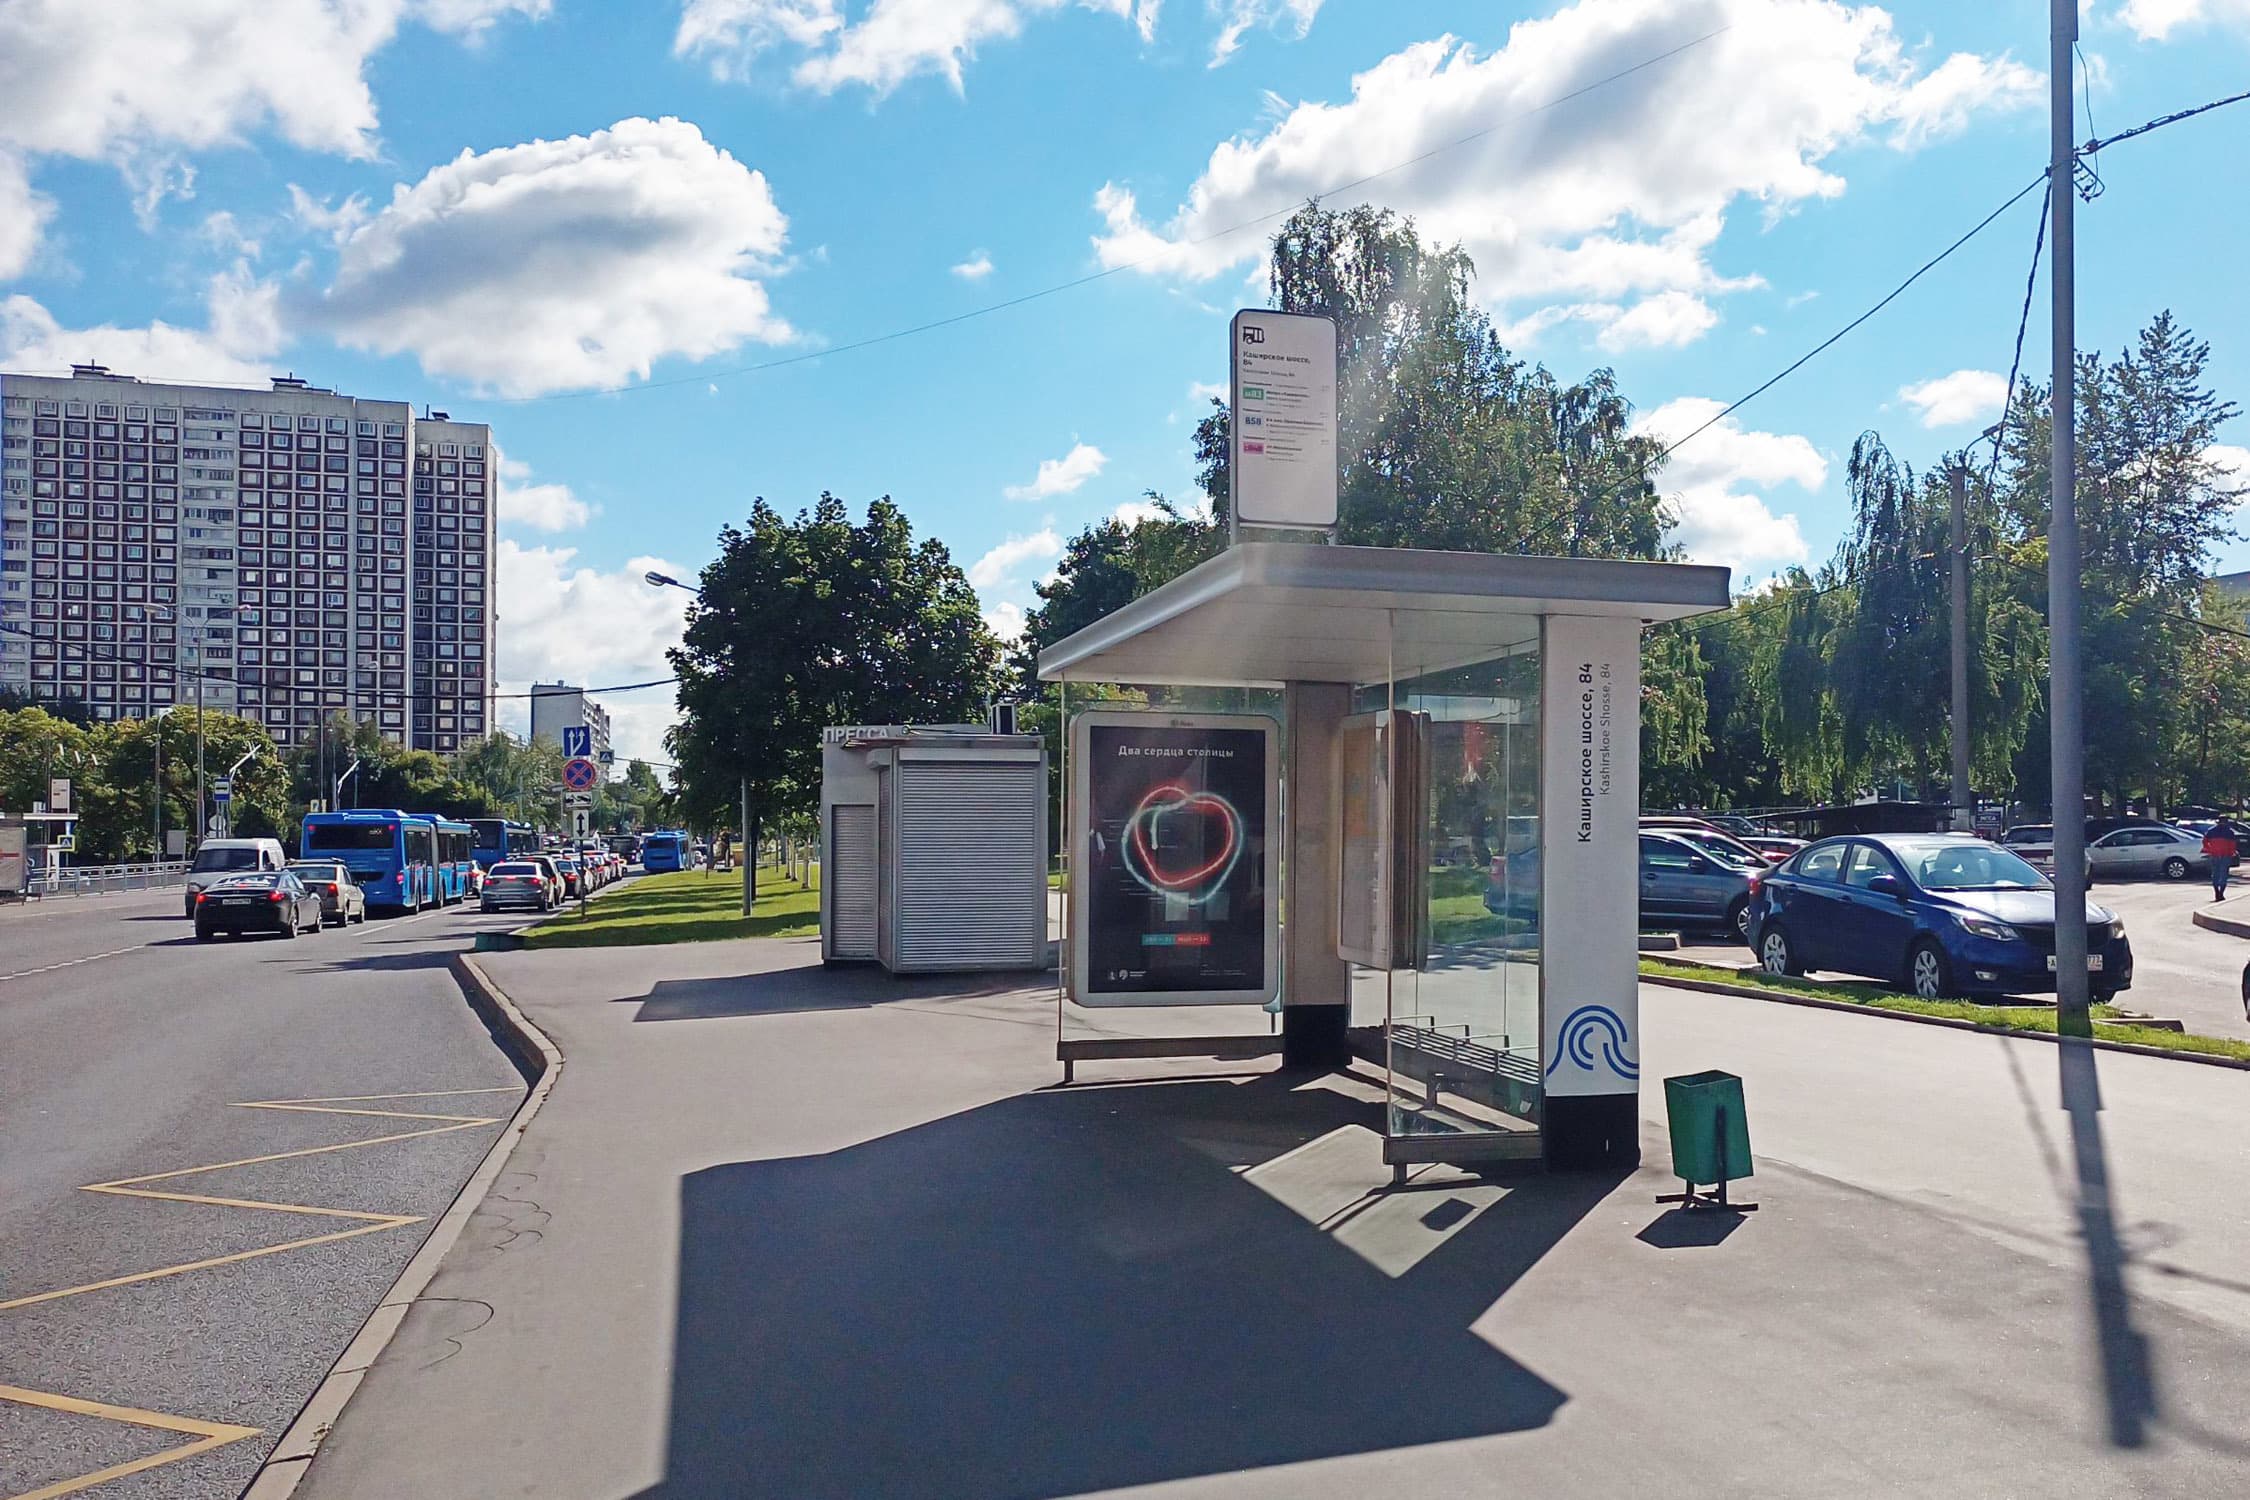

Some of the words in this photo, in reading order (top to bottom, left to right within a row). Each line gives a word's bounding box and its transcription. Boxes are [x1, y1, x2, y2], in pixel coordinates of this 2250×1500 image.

[1243, 351, 1284, 361] Каширское
[1579, 663, 1592, 684] 84
[1600, 663, 1611, 678] 84
[1599, 682, 1612, 727] Shosse,
[1581, 688, 1595, 743] шоссе,
[823, 727, 889, 743] ПРЕССА
[1118, 745, 1141, 756] Два
[1144, 747, 1184, 758] сердца
[1187, 748, 1234, 758] столицы
[1599, 730, 1611, 795] Kashirskoe
[1577, 748, 1595, 843] Каширское
